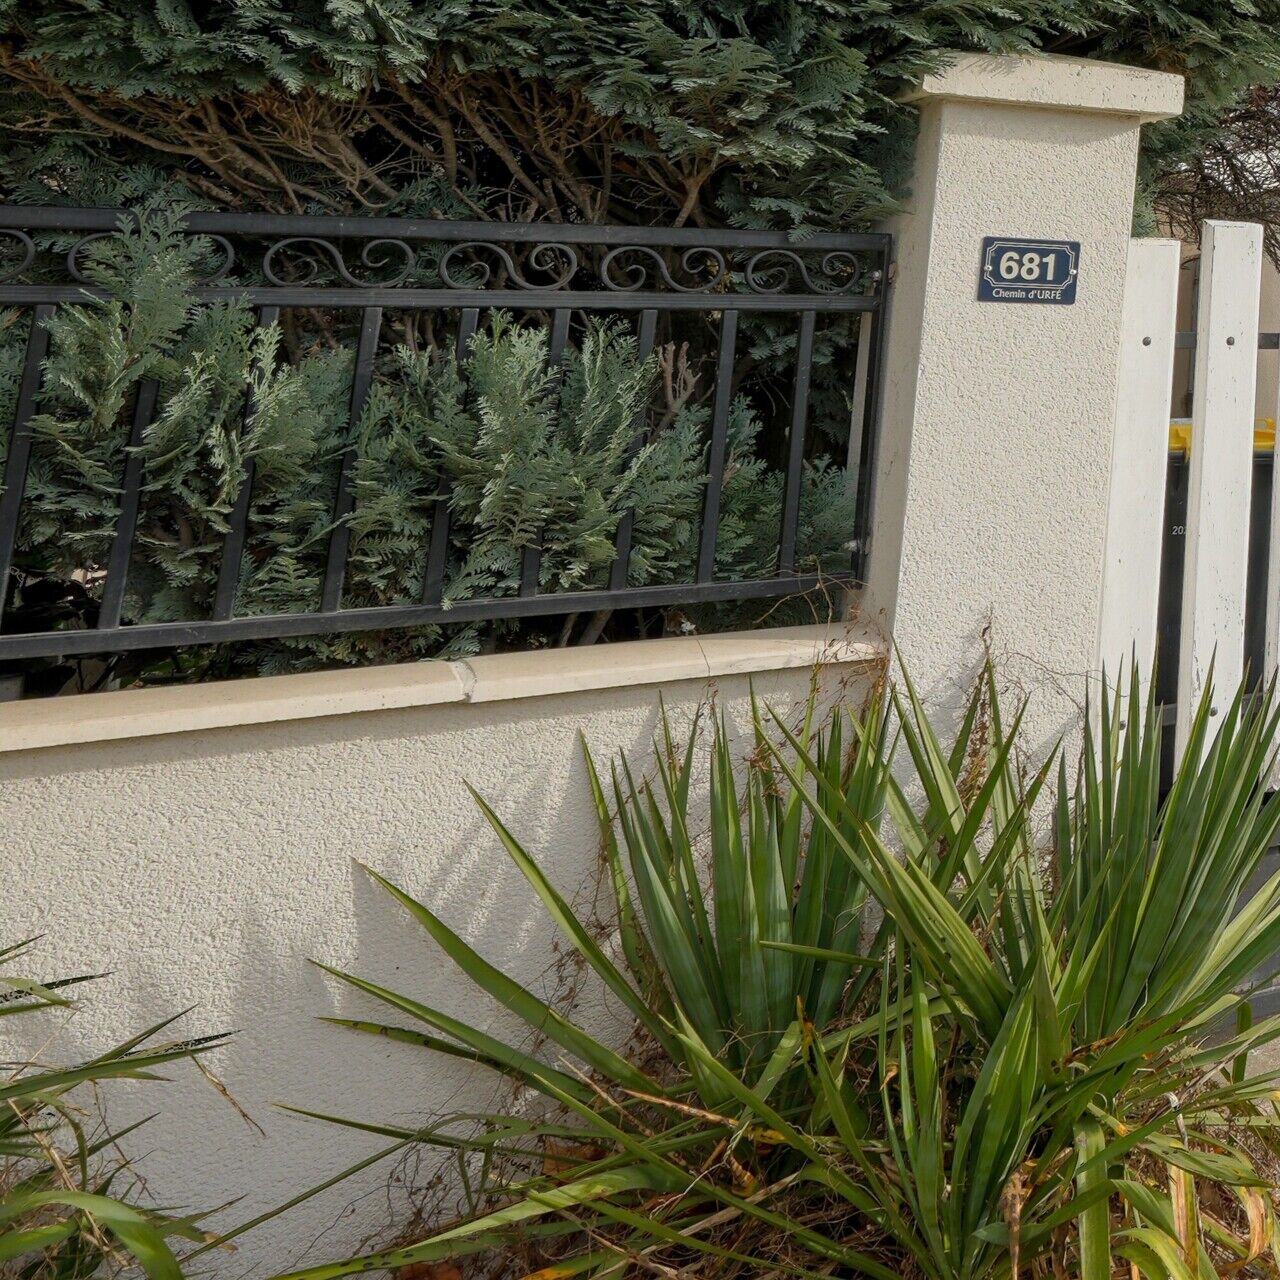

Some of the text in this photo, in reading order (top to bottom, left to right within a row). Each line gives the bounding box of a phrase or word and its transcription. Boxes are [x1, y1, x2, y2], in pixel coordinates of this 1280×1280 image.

[999, 251, 1056, 281] 681
[992, 288, 1062, 300] Chemin d'URFÉ
[1172, 525, 1186, 535] 20
